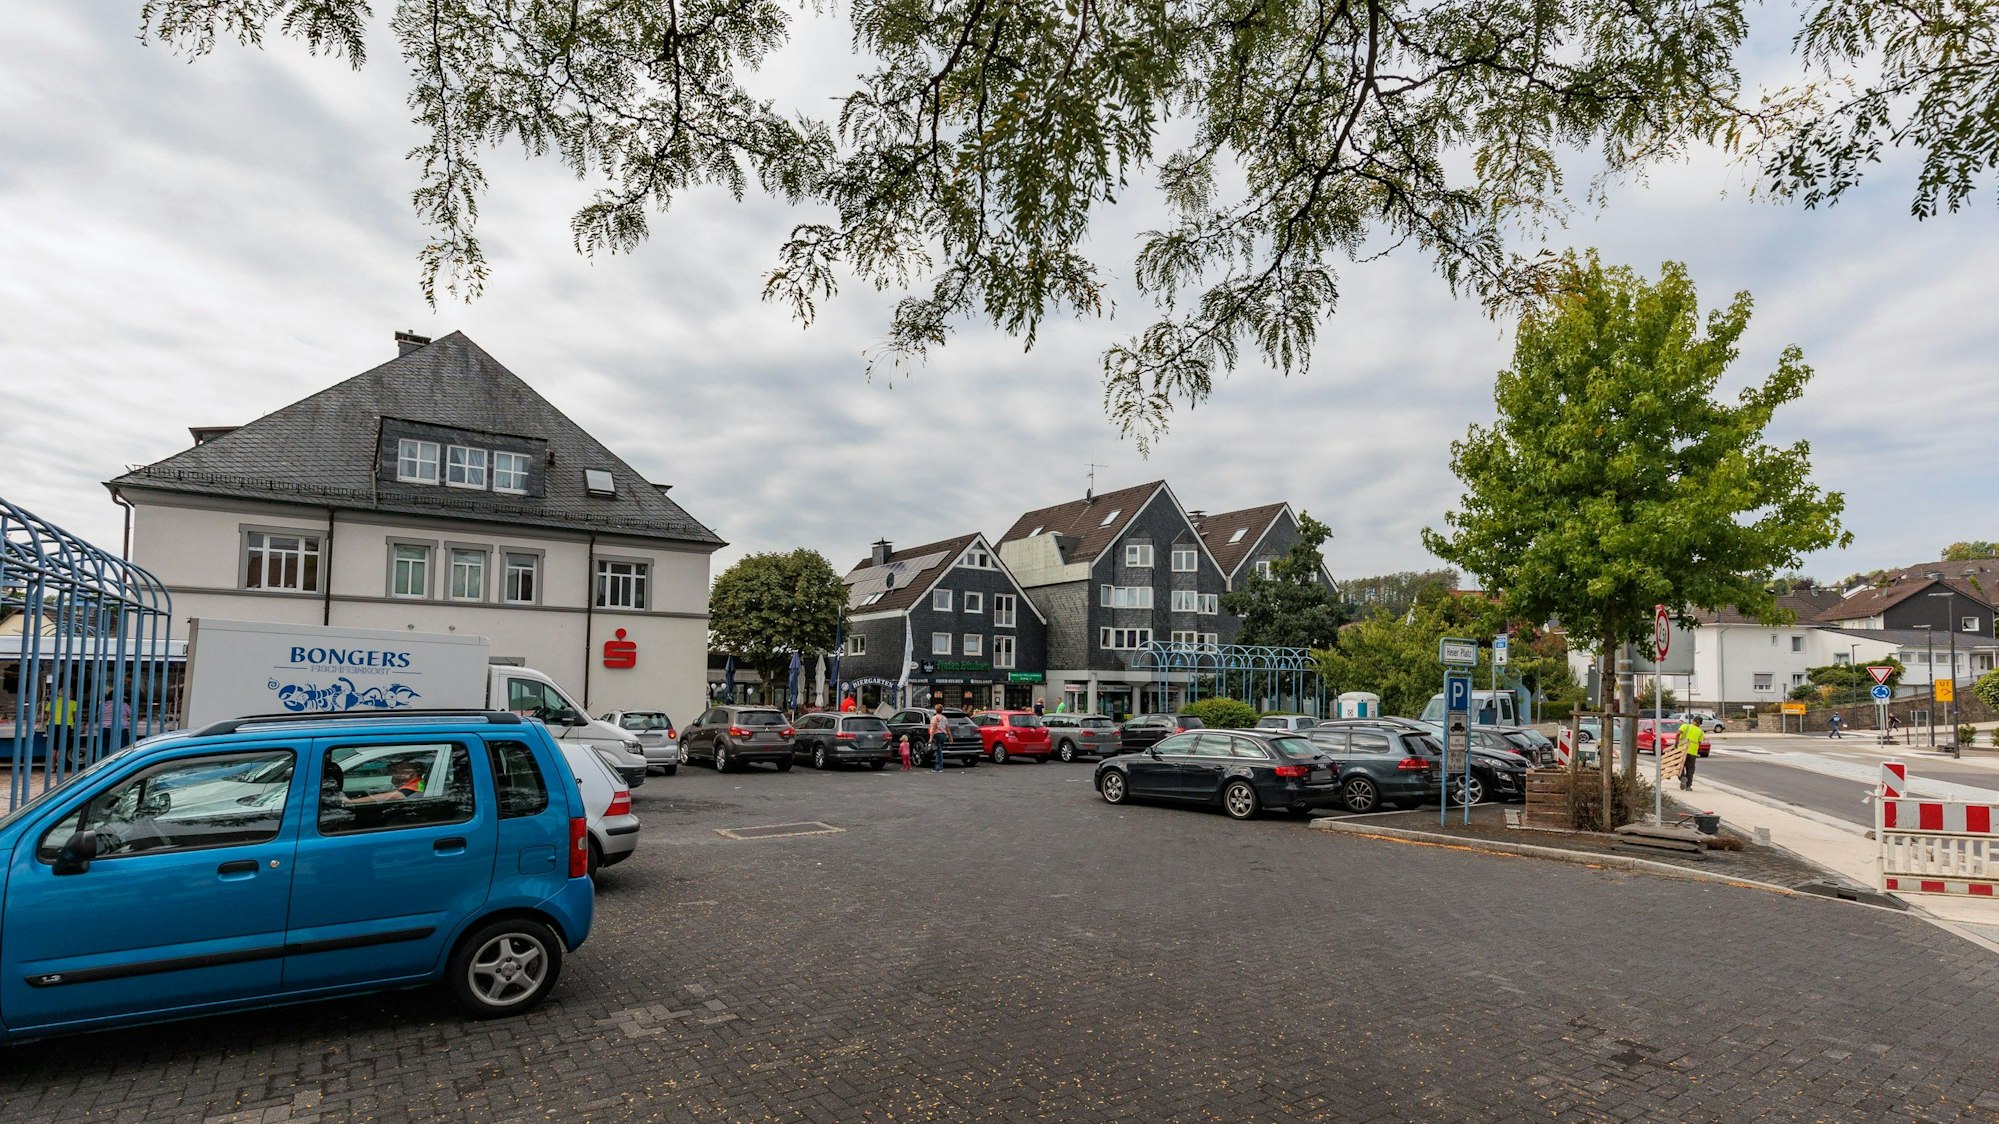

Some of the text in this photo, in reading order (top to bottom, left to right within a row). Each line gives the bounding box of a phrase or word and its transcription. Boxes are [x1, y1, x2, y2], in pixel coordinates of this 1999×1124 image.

[290, 646, 411, 668] BONGERS
[1461, 648, 1472, 658] Platz
[310, 666, 391, 675] FISCHFEINKOST
[852, 677, 894, 689] BIERGARTEN
[1453, 682, 1464, 707] P
